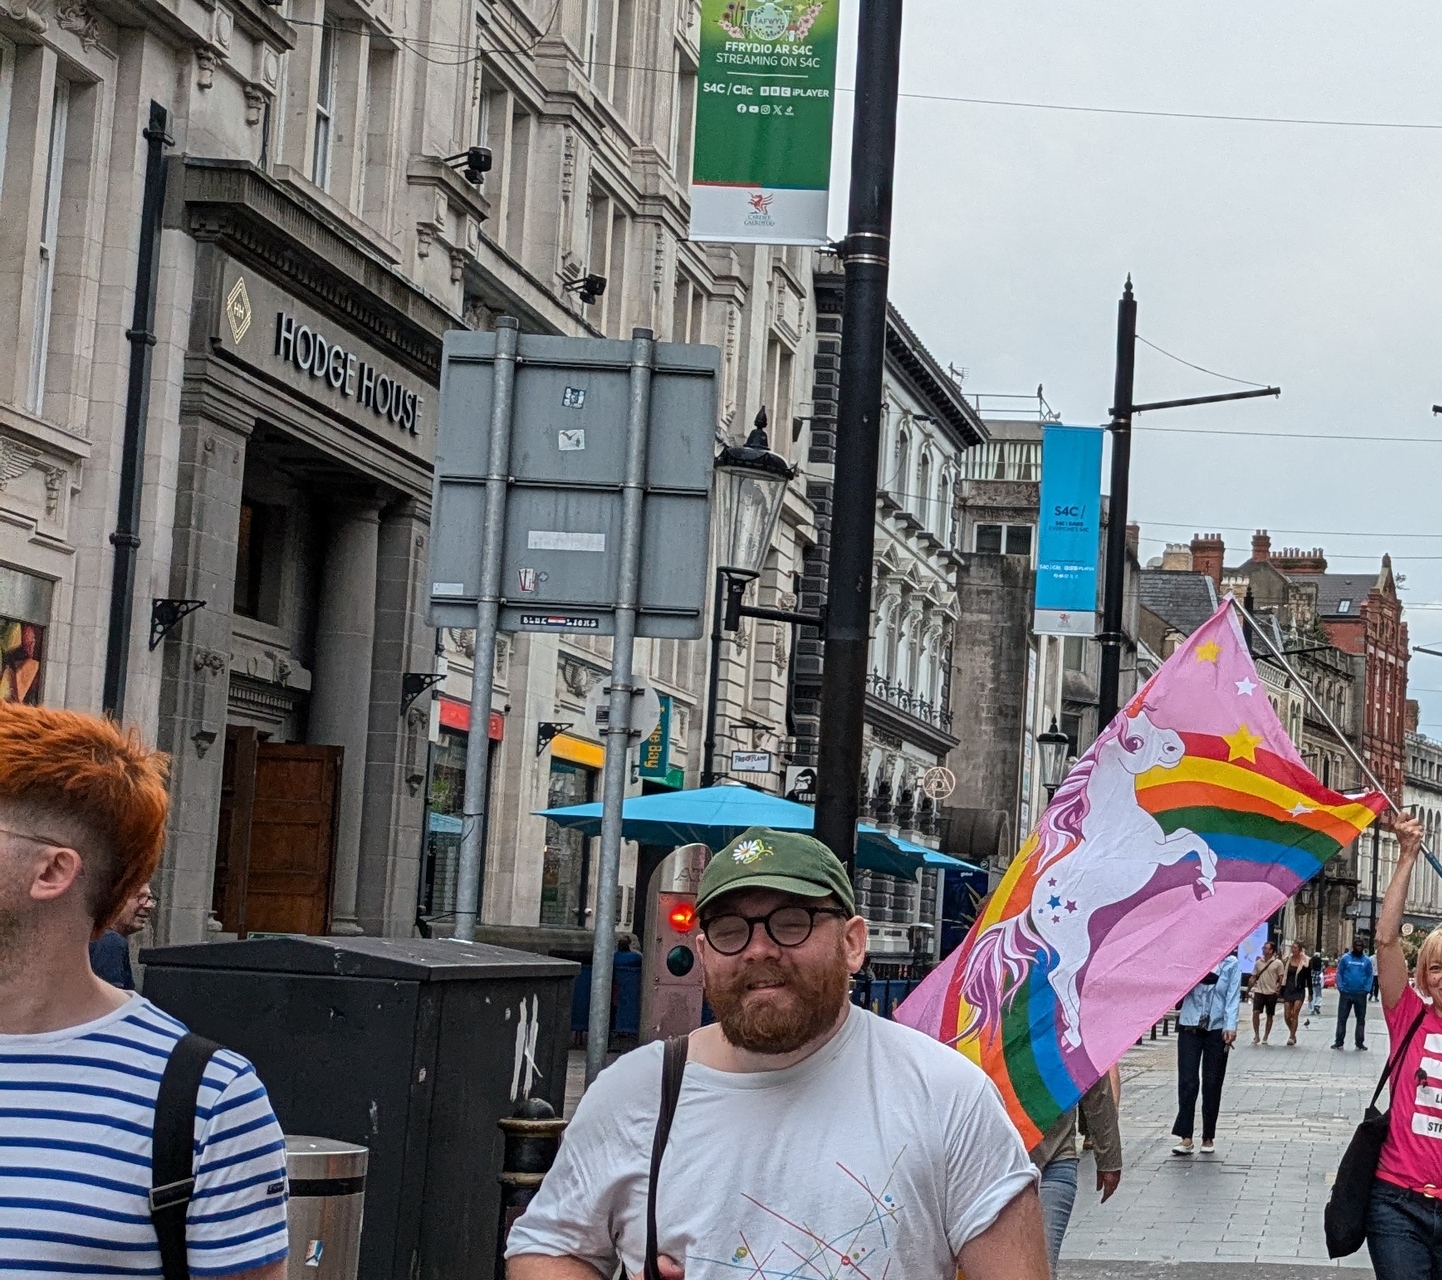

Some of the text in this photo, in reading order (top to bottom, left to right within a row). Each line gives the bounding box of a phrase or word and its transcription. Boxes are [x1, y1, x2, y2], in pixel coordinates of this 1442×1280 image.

[725, 41, 813, 55] FFRYDIO AR S4C
[716, 52, 820, 68] STREAMING ON S4C
[792, 89, 829, 98] iPLAYER
[275, 312, 424, 435] HODGE HOUSE
[1054, 505, 1078, 516] S4C
